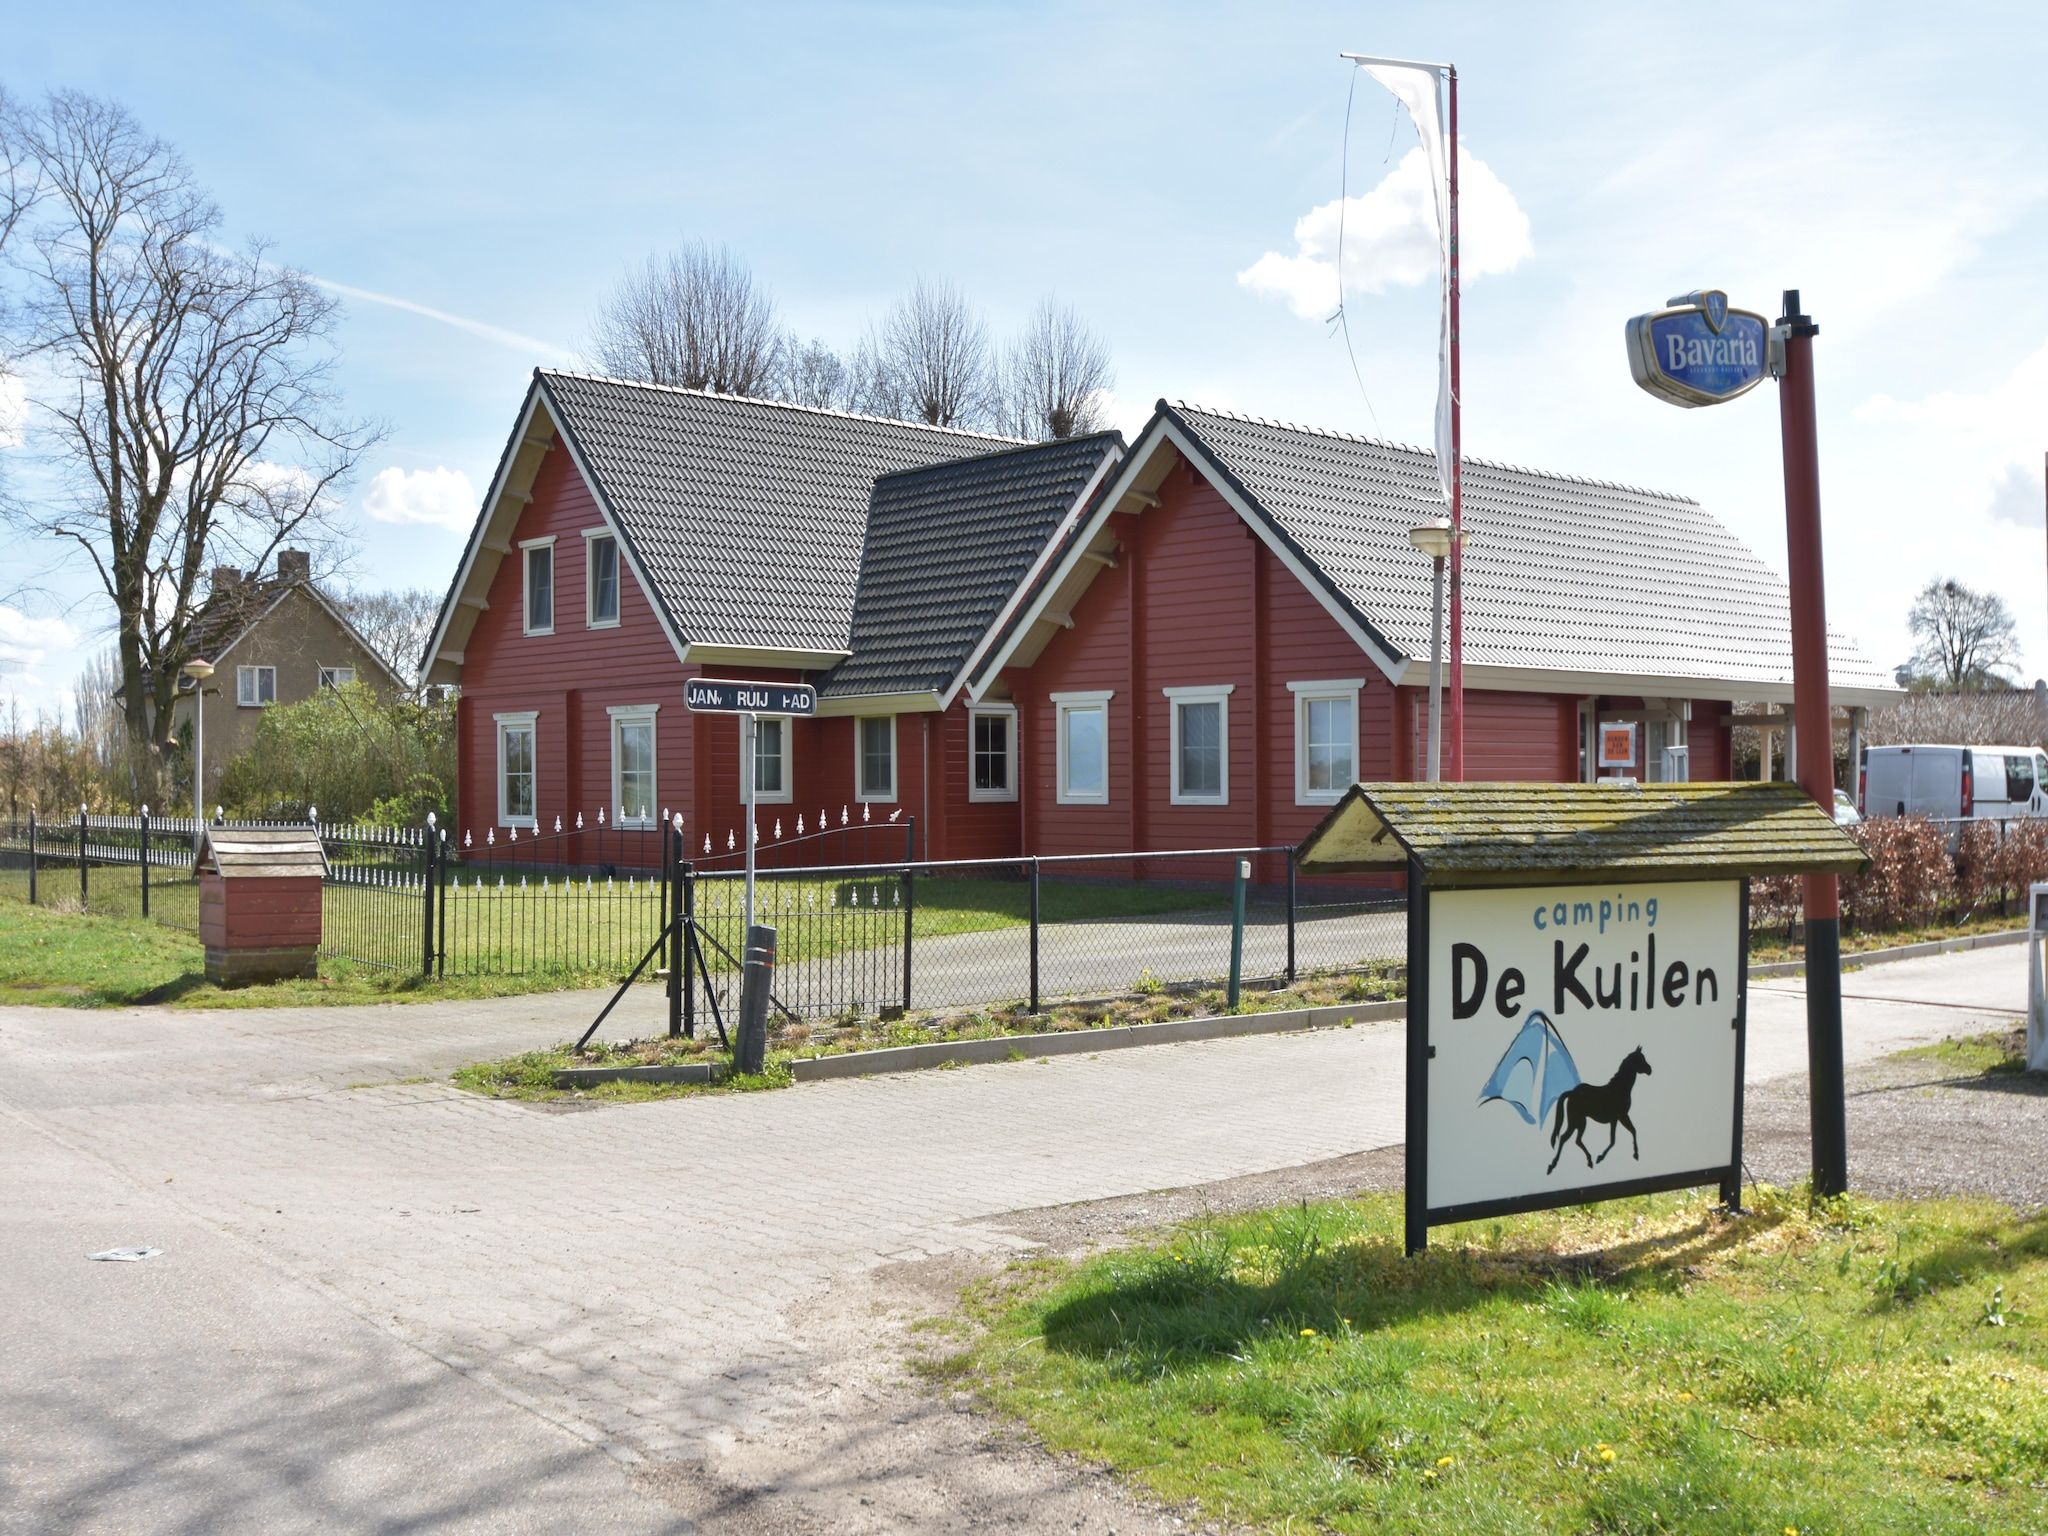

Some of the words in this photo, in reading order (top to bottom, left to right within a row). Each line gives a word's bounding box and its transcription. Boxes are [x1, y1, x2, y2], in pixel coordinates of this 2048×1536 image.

[1666, 331, 1758, 371] Bavaria
[1533, 893, 1658, 934] camping
[1451, 942, 1525, 1020] De
[1554, 932, 1718, 1015] Kuilen
